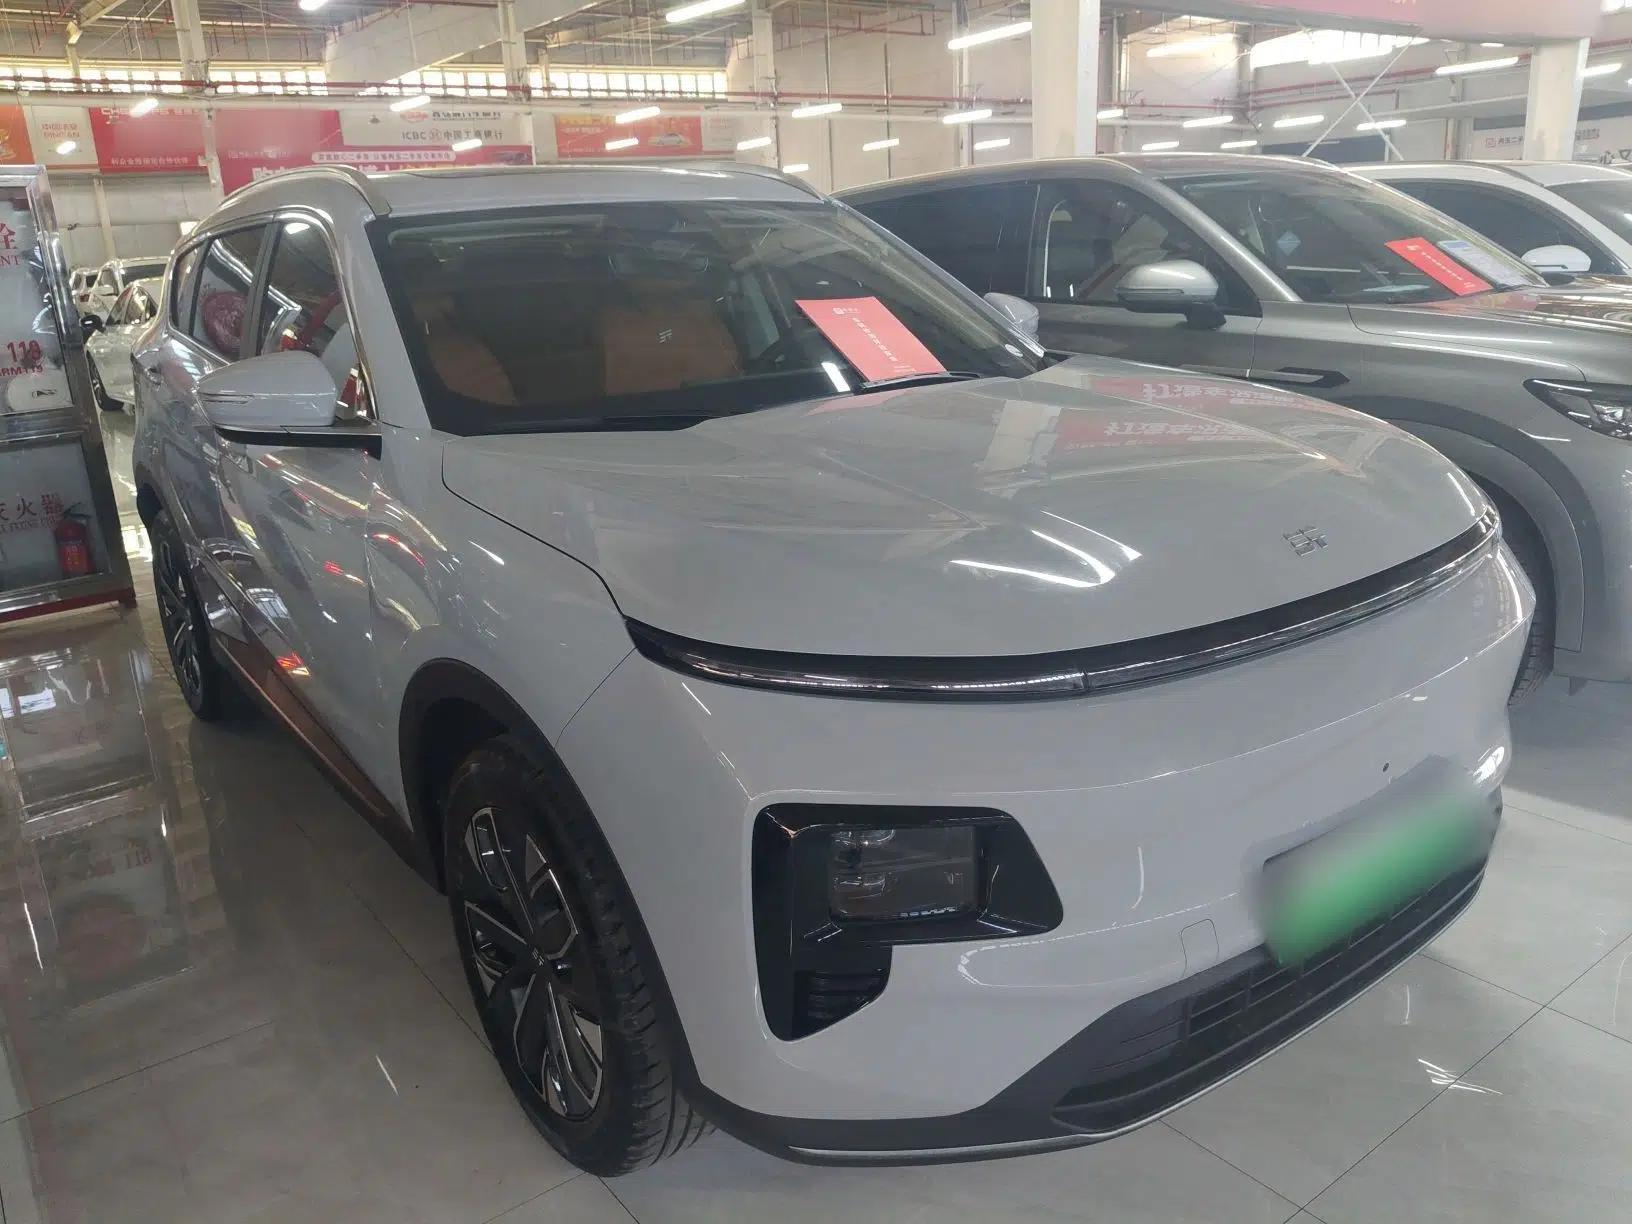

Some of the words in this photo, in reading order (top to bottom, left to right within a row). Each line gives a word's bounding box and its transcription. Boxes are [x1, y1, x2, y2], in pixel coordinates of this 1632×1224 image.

[402, 131, 426, 141] ICBC
[443, 127, 504, 142] 中国工商银行
